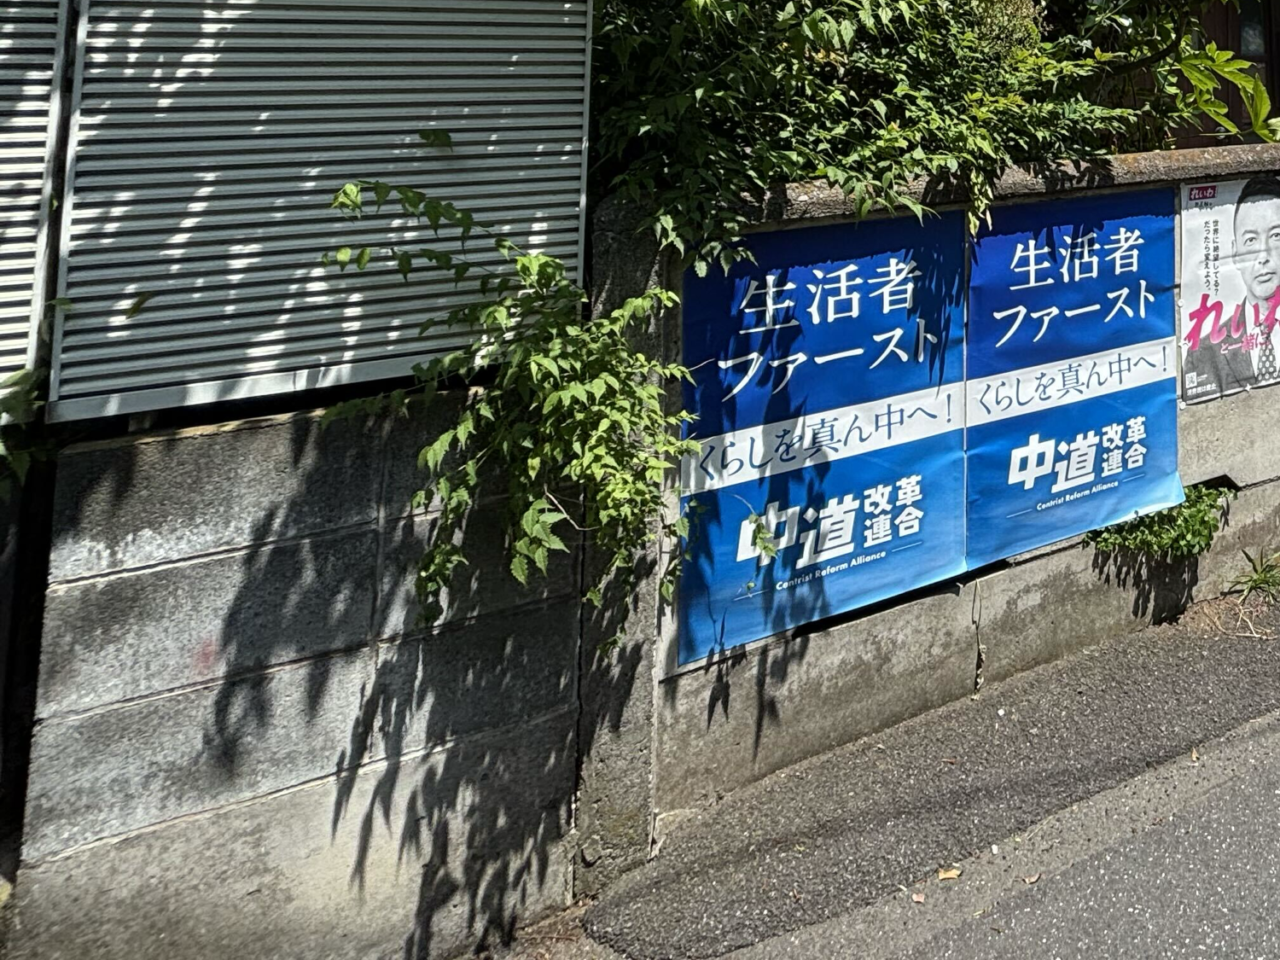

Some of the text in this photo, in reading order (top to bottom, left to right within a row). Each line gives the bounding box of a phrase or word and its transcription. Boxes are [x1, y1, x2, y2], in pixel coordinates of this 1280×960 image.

[1190, 188, 1214, 200] れいわ
[1009, 227, 1145, 290] 生活者
[739, 258, 922, 334] 生活者
[993, 279, 1155, 348] ファースト
[717, 318, 938, 402] ファースト
[1221, 333, 1271, 354] と一緒に
[979, 345, 1167, 415] くらしを真ん中へ！
[699, 393, 952, 481] くらしを真ん中へ！
[1102, 415, 1147, 449] 改革
[1008, 430, 1100, 493] 中道
[1101, 443, 1147, 477] 連合
[863, 474, 922, 515] 改革
[1036, 480, 1119, 511] Centrist Reform Alliance
[736, 494, 860, 570] 中道
[863, 506, 924, 548] 連合
[776, 550, 886, 591] Centrist Reform Alliance
